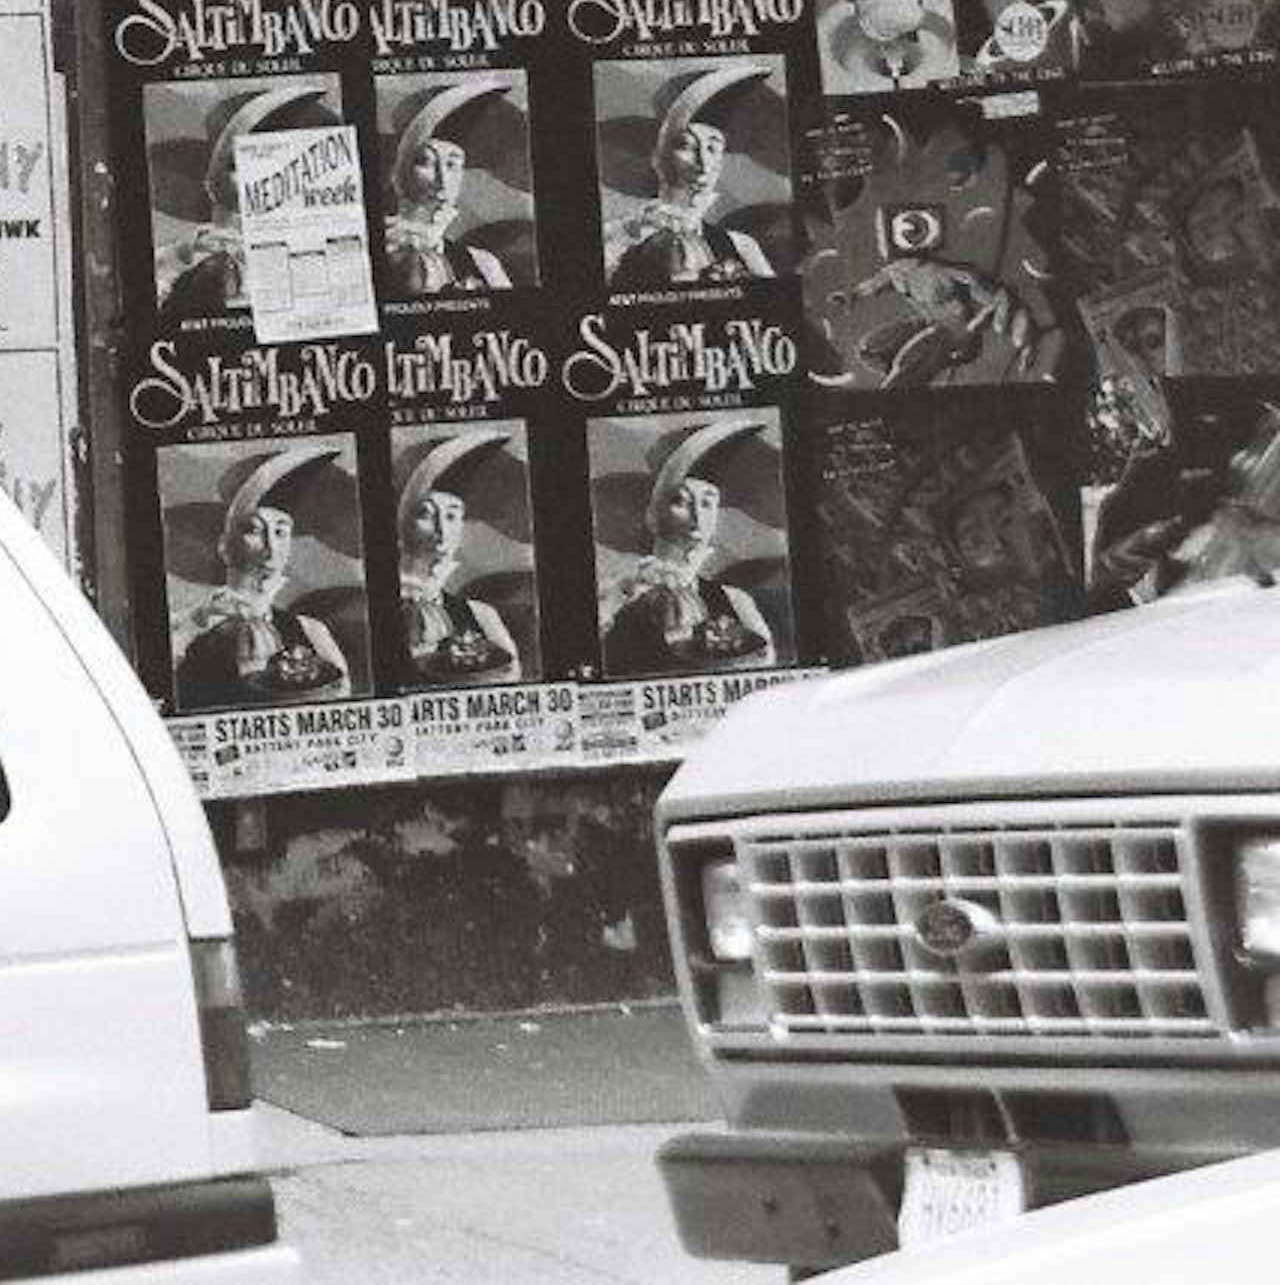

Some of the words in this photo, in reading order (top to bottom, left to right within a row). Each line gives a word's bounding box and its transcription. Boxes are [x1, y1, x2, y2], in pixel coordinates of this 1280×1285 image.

[243, 132, 354, 217] MEDITATION
[468, 692, 540, 718] MARCH
[548, 688, 573, 712] 30
[643, 681, 717, 710] STARTS
[215, 717, 290, 744] STARTS
[298, 710, 372, 737] MARCH
[377, 704, 403, 728] 30
